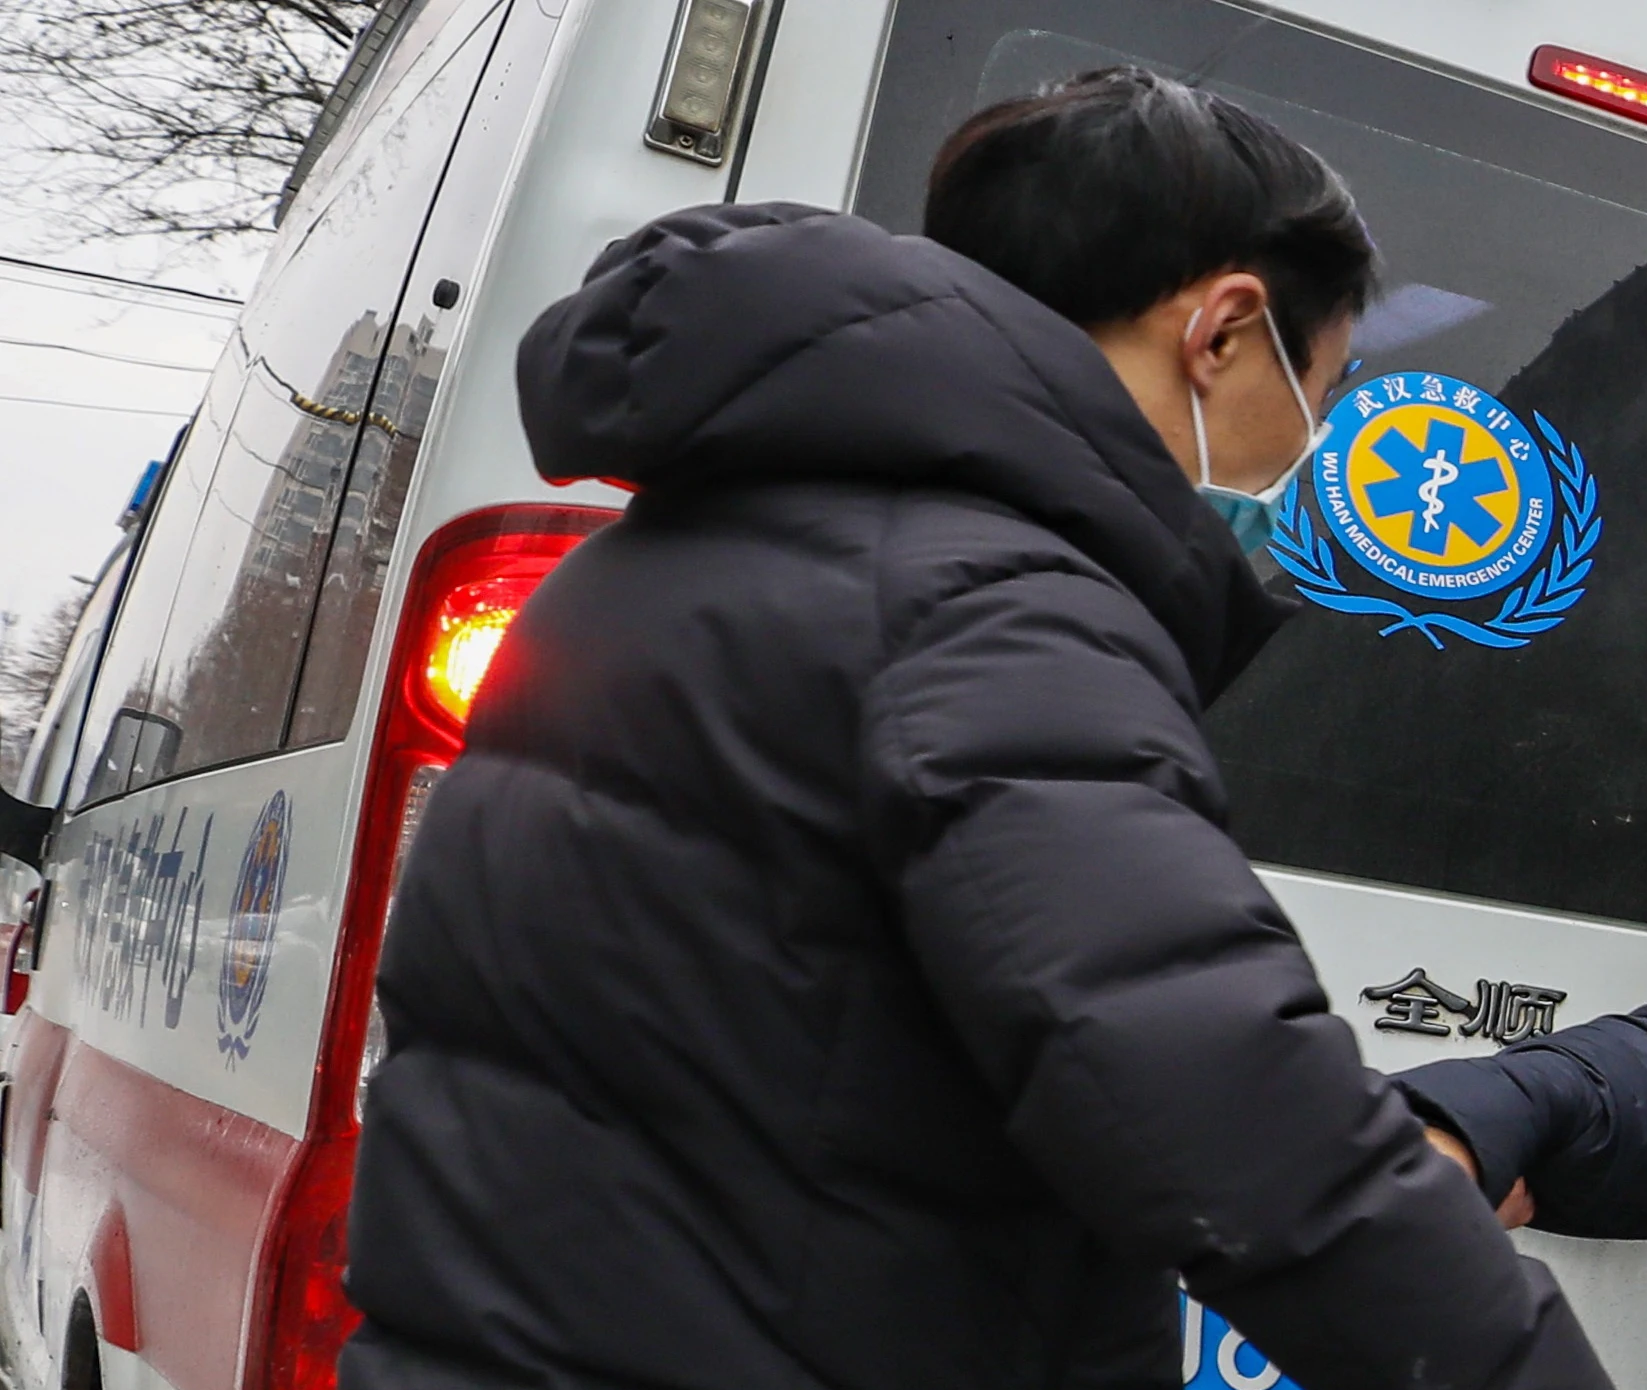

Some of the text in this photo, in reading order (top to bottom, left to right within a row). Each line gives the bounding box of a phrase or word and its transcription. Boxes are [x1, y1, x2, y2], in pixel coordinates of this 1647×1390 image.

[1353, 374, 1530, 462] 武汉急救中心
[1345, 524, 1416, 584] MEDICAL
[1418, 551, 1517, 589] EMERGENCY
[1512, 497, 1544, 556] CENTER
[1362, 966, 1568, 1045] 全顺
